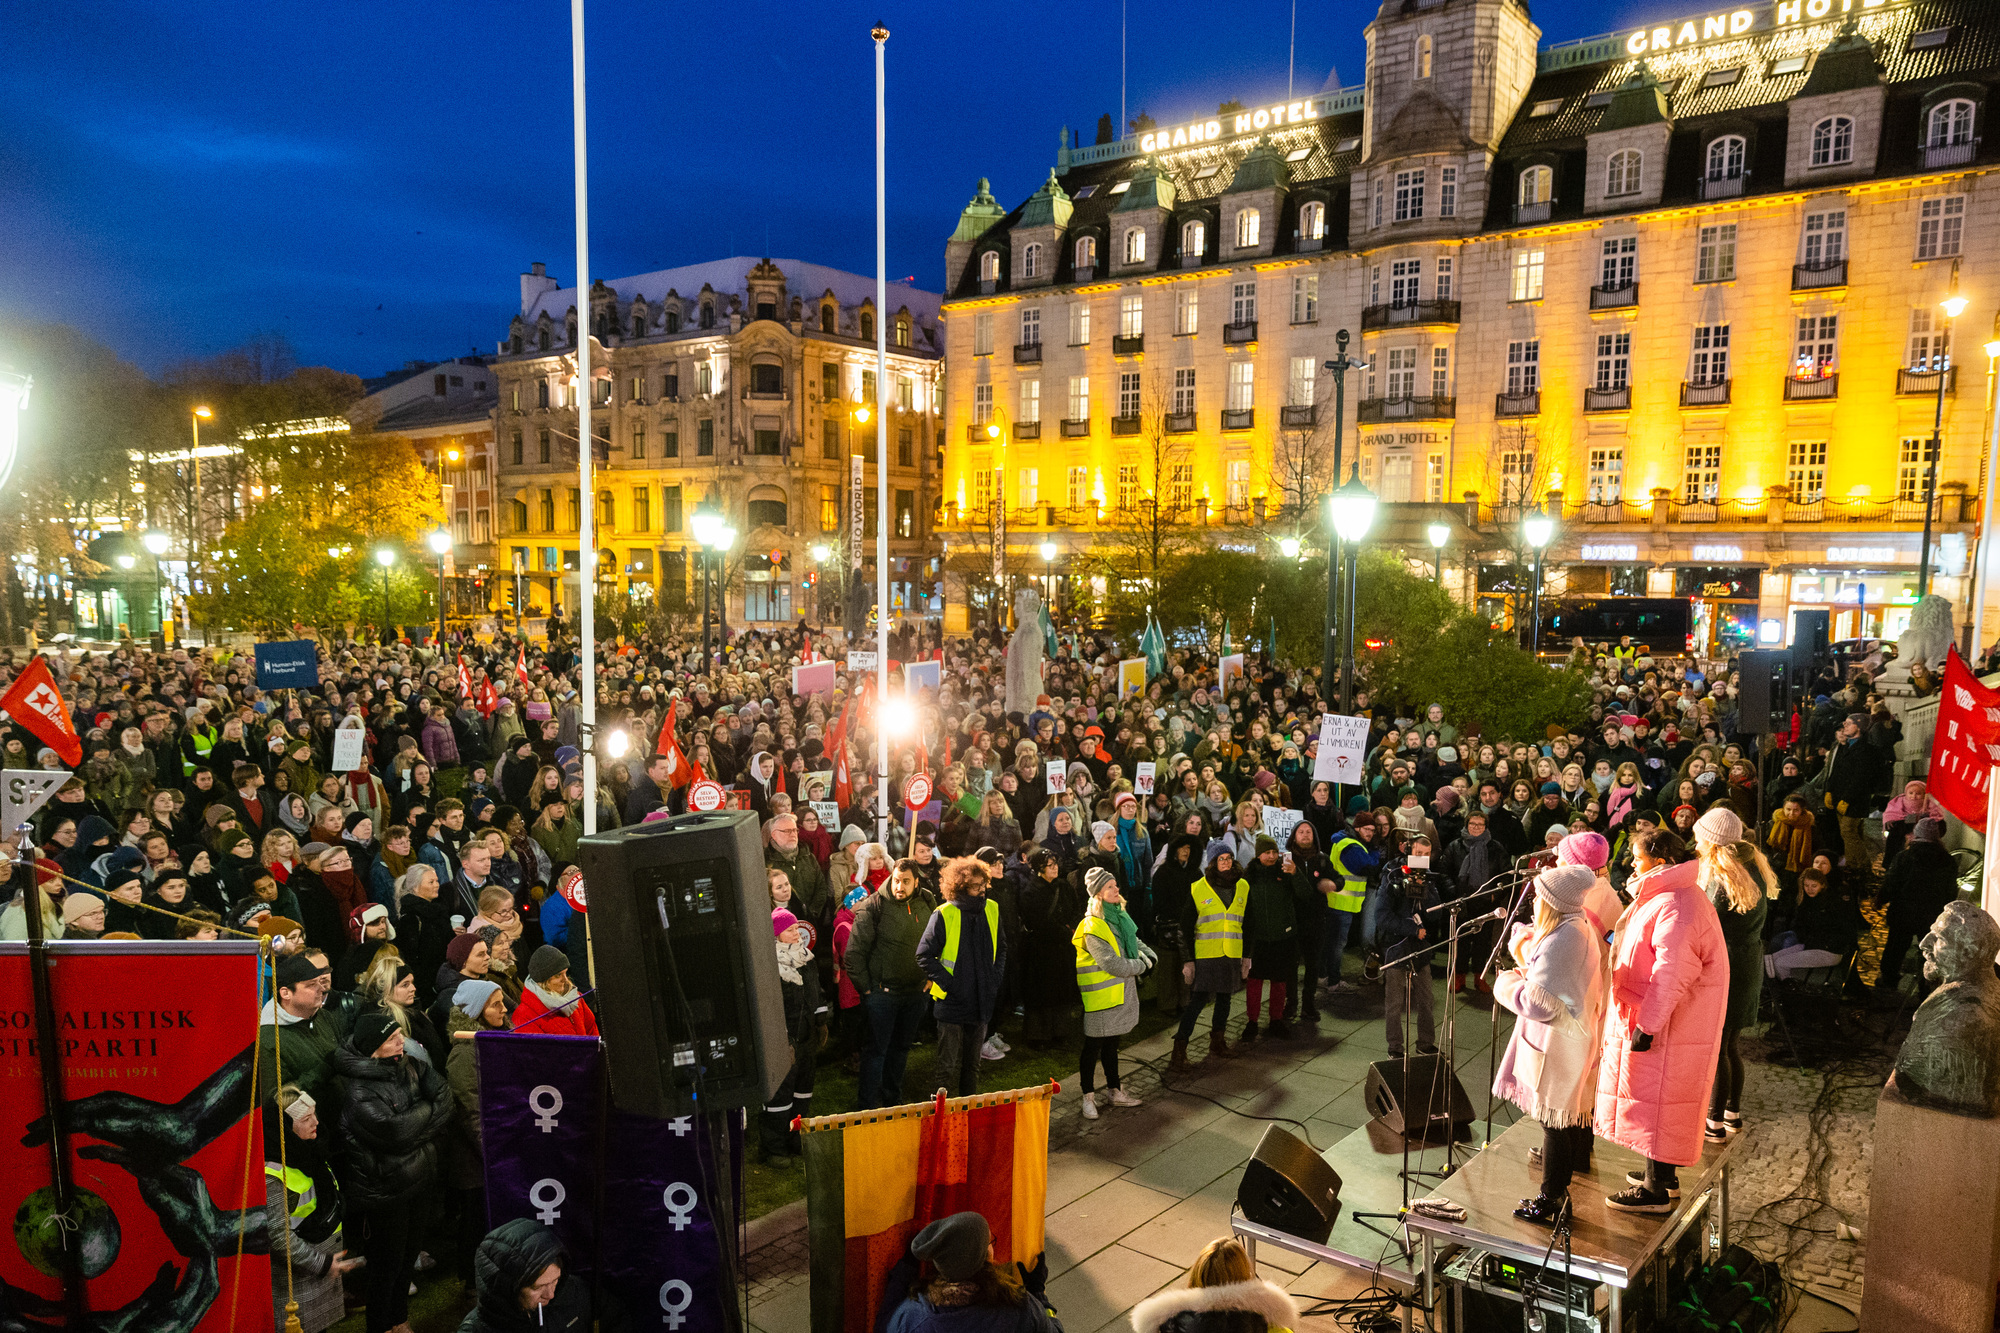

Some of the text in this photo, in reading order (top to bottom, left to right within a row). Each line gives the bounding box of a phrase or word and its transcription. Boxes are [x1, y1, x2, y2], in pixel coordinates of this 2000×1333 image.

[1627, 10, 1753, 54] GRAND
[1140, 100, 1317, 153] GRAND HOTEL
[1364, 432, 1442, 446] GRAND HOTEL
[854, 477, 862, 524] WORLD
[854, 528, 862, 559] OSLO
[1694, 545, 1742, 561] FREIA
[1702, 581, 1731, 596] Freia
[271, 660, 306, 669] Human-Etisk
[1323, 715, 1369, 729] ERNA & KRF
[1331, 727, 1357, 737] UT AV
[1319, 737, 1364, 750] LIVMOREN!
[1270, 810, 1294, 821] DENNE
[0, 1010, 196, 1030] SOALISTISK
